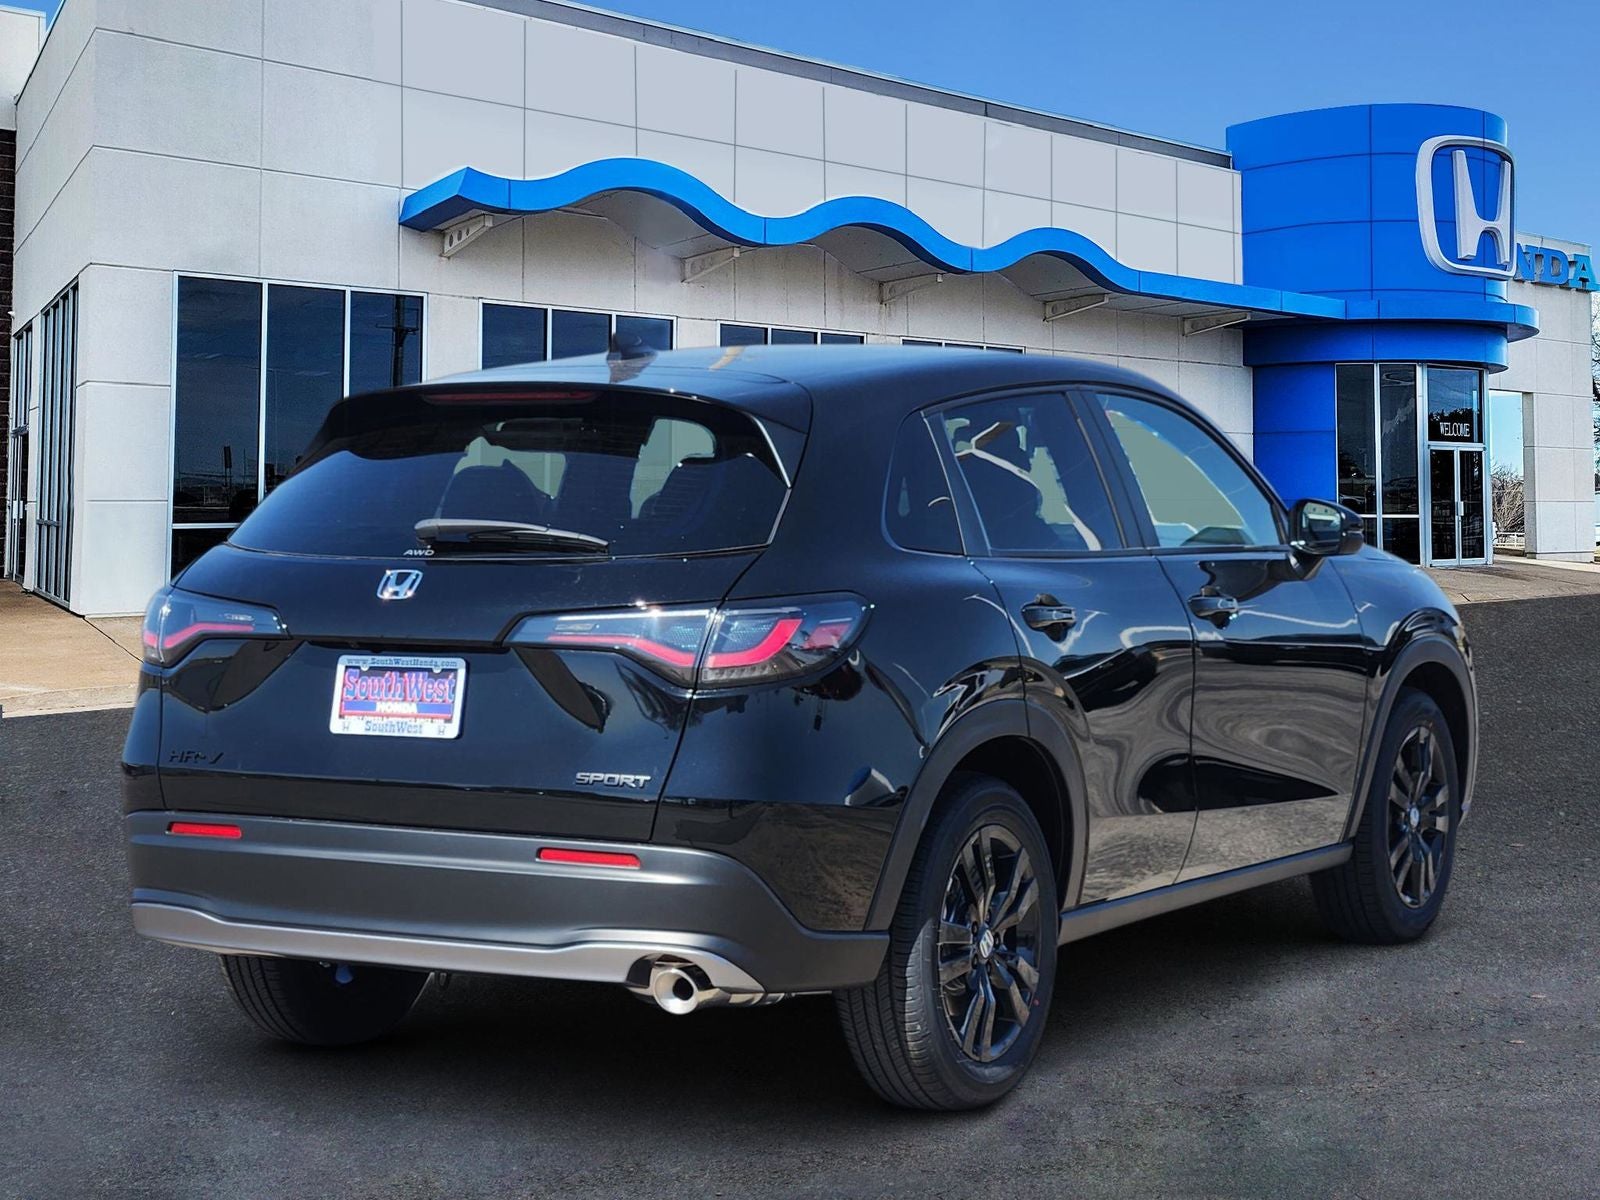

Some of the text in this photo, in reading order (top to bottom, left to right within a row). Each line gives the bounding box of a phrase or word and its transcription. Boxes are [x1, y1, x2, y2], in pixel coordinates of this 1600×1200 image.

[1439, 422, 1470, 437] WELCOME
[344, 668, 456, 701] SouthWest
[376, 701, 417, 713] HONDA
[364, 720, 423, 734] SouthWest
[575, 772, 652, 789] SPORT
